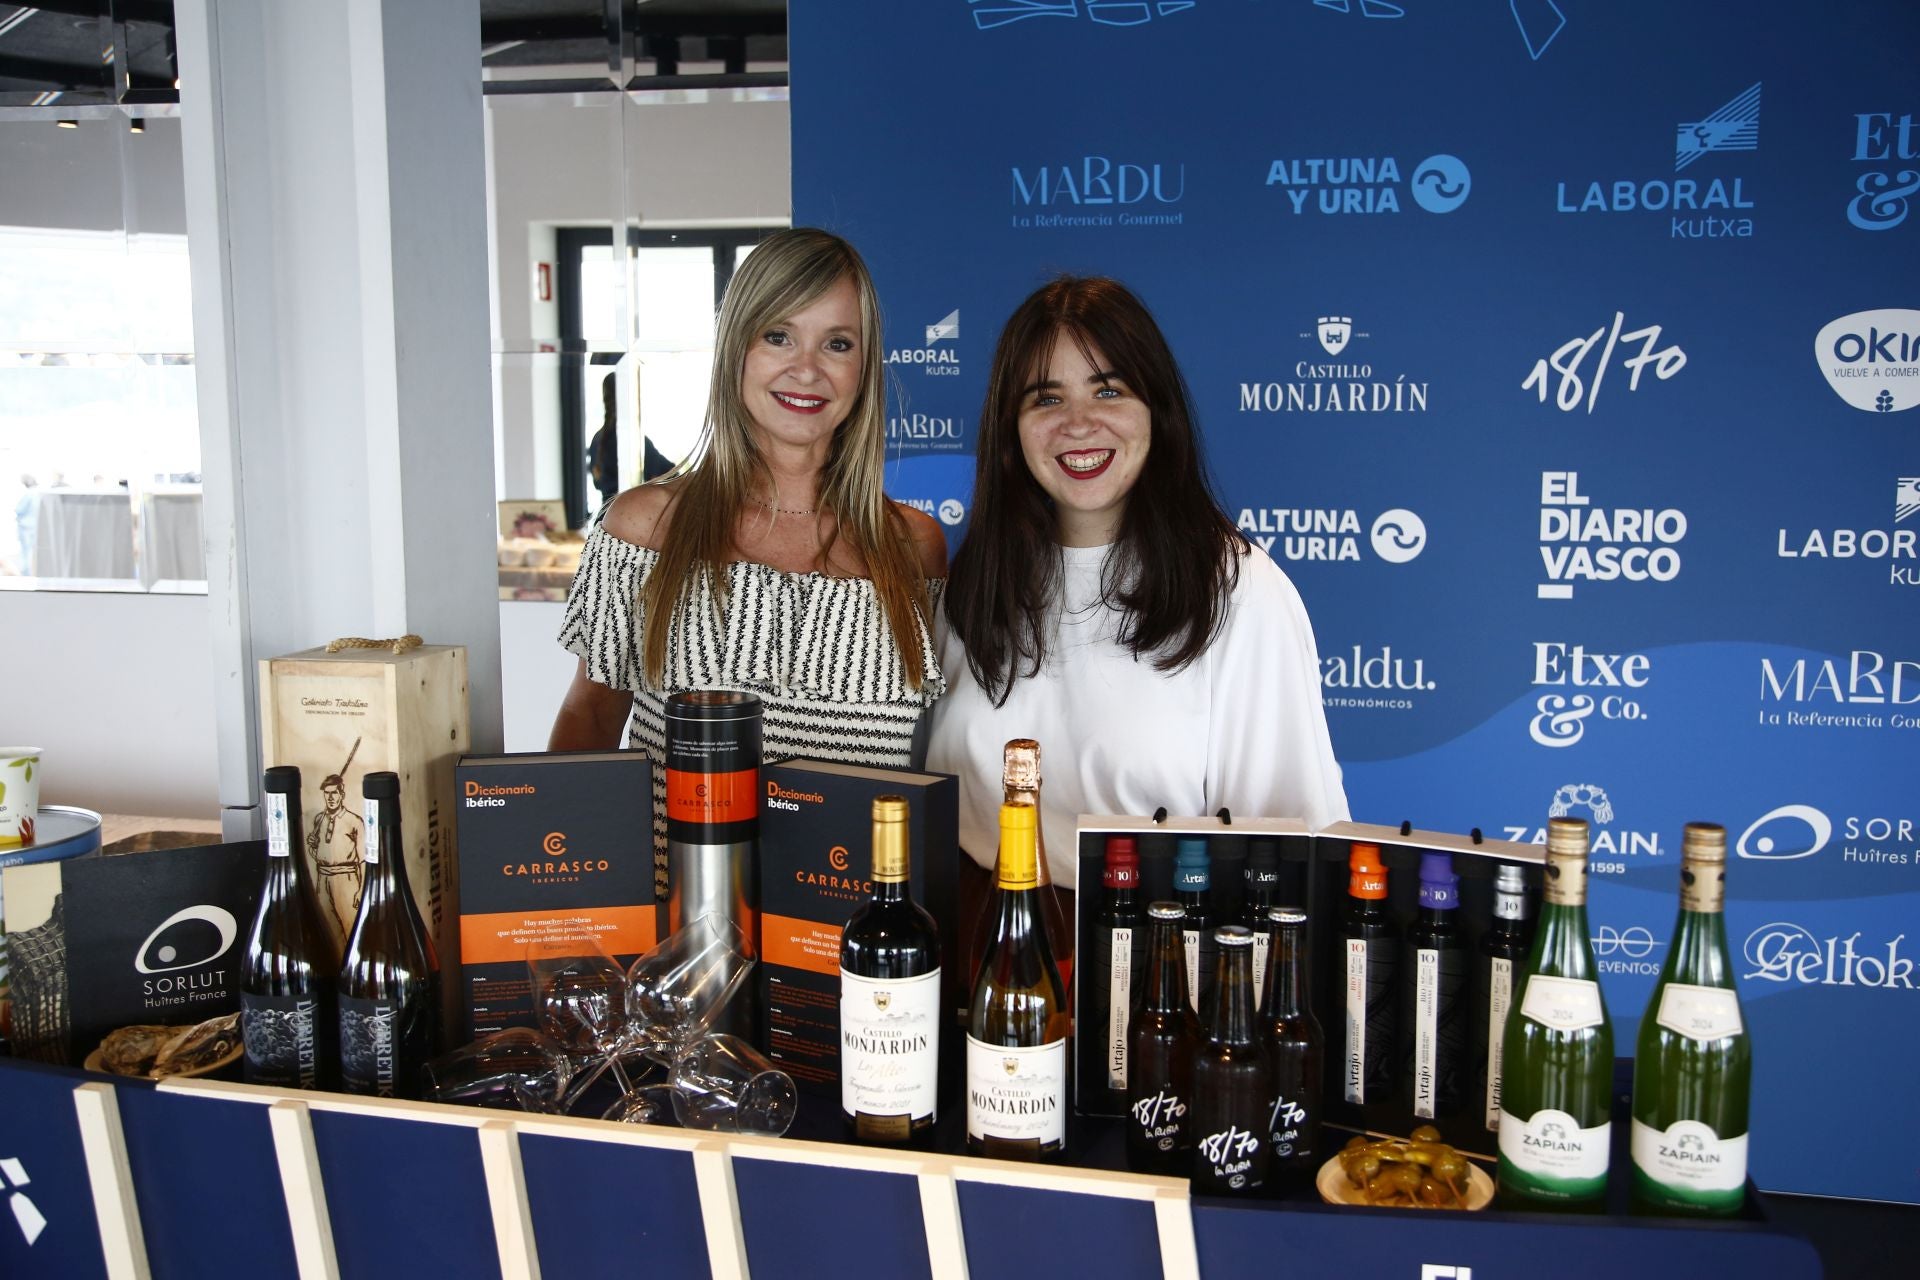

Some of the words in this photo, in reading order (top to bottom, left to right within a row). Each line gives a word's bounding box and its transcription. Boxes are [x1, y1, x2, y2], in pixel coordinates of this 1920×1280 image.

[1850, 112, 1920, 161] Et
[1012, 156, 1185, 205] MARDU
[1265, 157, 1401, 186] ALTUNA
[1287, 190, 1305, 214] Y
[1319, 187, 1401, 214] URIA
[1556, 178, 1755, 213] LABORAL
[1671, 216, 1754, 239] kutxa
[883, 349, 960, 363] ABORAL
[1521, 310, 1688, 415] 18/70
[926, 365, 961, 376] kutxa
[1296, 361, 1372, 379] CASTILLO
[1834, 367, 1869, 378] VUELVE
[1873, 367, 1881, 378] A
[1885, 367, 1919, 378] COMER
[1239, 374, 1429, 412] MONJARDÍN
[1541, 471, 1590, 505] EL
[1235, 508, 1361, 533] ALTUNA
[1540, 508, 1688, 543] DIARIO
[1285, 536, 1361, 561] URIA
[1540, 546, 1682, 582] VASCO
[1531, 641, 1651, 689] Etxe
[1529, 694, 1595, 748] &
[1601, 695, 1649, 721] Co.
[1759, 710, 1780, 726] La
[1787, 711, 1883, 727] Referencia
[465, 780, 536, 798] Diccionario
[767, 781, 824, 804] Diccionario
[466, 797, 506, 808] ibérico
[767, 798, 800, 812] ibérico
[1844, 847, 1908, 864] Huîtres
[503, 859, 610, 877] CARRASCO
[1117, 871, 1129, 881] 10
[1434, 889, 1447, 900] 10
[1504, 900, 1518, 912] 10
[1115, 932, 1129, 942] 10
[1351, 943, 1365, 953] 10
[1420, 953, 1435, 963] 10
[1495, 962, 1510, 973] 10
[1597, 960, 1660, 976] EVENTOS
[143, 970, 226, 996] SORLUT
[145, 995, 186, 1009] Huîtres
[189, 989, 227, 1003] France
[844, 1030, 928, 1055] MONJARDÍN
[863, 1026, 902, 1038] CASTILLO
[1112, 1039, 1126, 1077] Artajo
[1348, 1053, 1363, 1091] Artajo
[991, 1086, 1032, 1098] CASTILLO
[1418, 1066, 1432, 1105] Artajo
[971, 1089, 1057, 1115] MONJARDÍN
[1132, 1090, 1187, 1129] 18/70
[1198, 1125, 1259, 1166] 18/70
[1523, 1134, 1583, 1153] ZAPIAIN
[1658, 1145, 1722, 1164] ZAPIAIN
